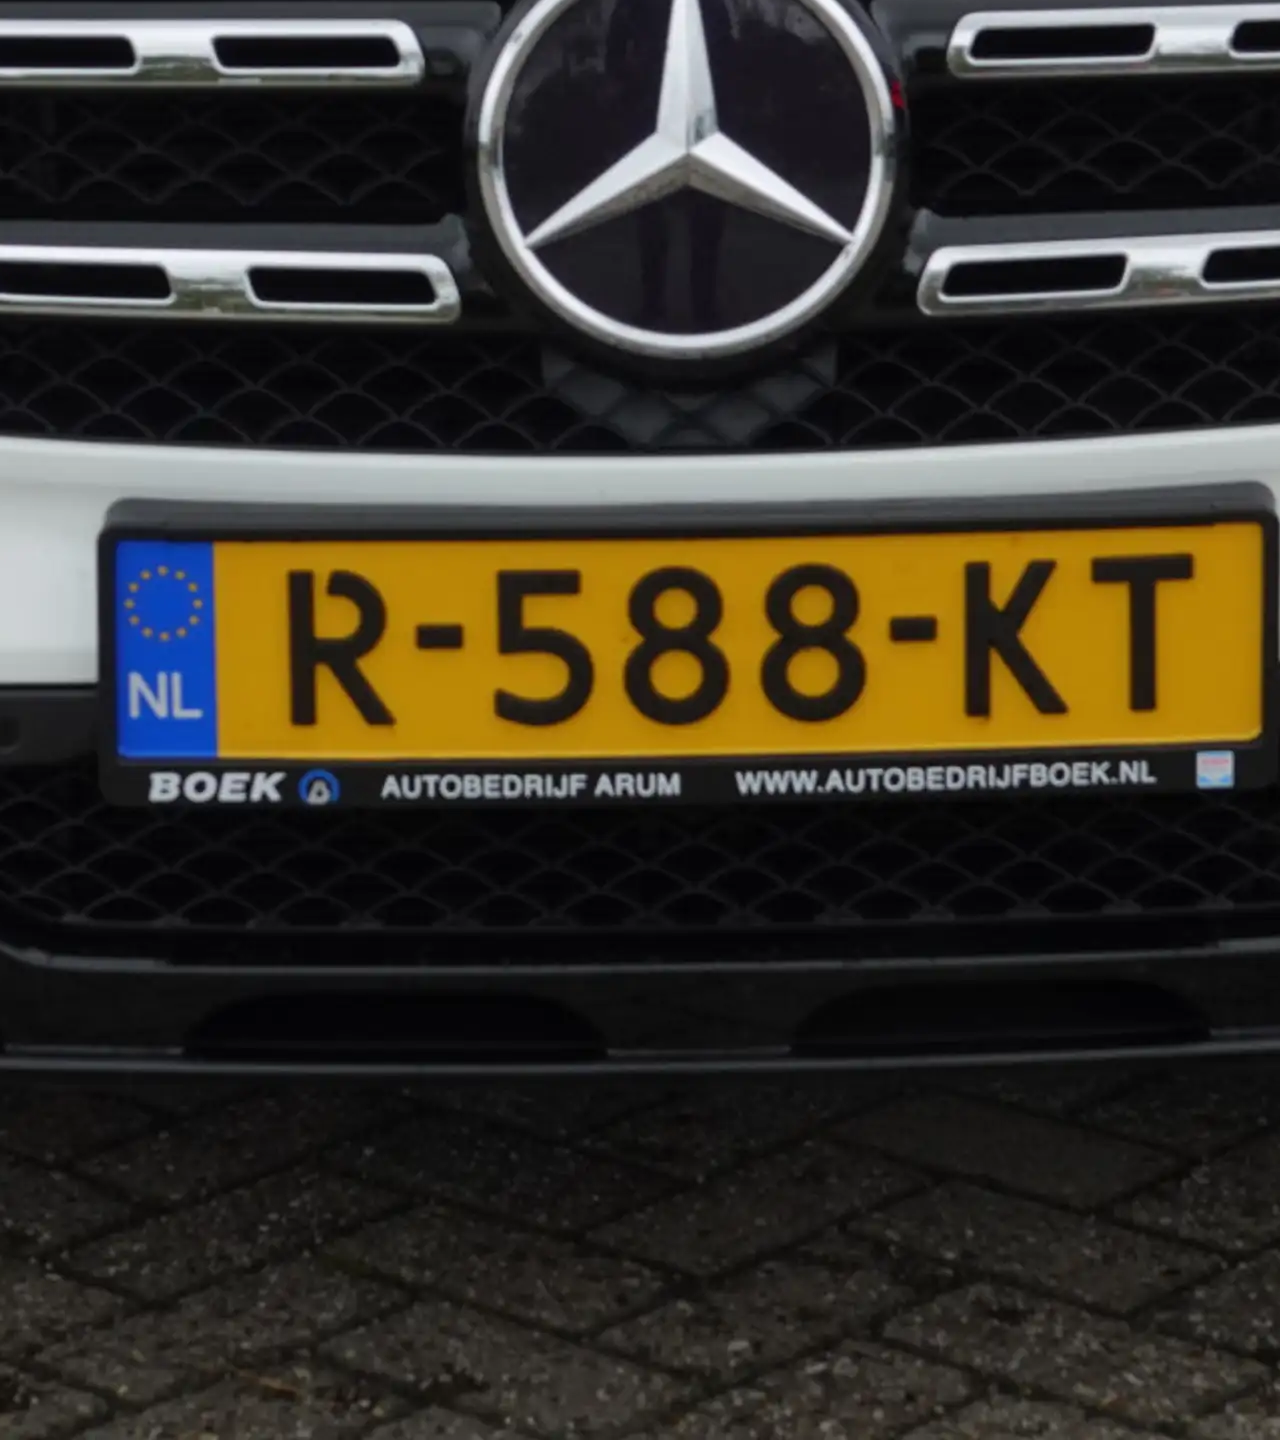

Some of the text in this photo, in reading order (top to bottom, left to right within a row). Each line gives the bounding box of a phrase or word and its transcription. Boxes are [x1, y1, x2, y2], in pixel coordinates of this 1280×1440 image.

[287, 553, 1194, 727] R-588-KT
[129, 674, 201, 720] NL
[148, 771, 286, 803] BOEK
[381, 772, 681, 799] AUTOBEDRIJF ARUM
[735, 760, 1156, 795] WWW.AUTOBEDRIJFBOEK.NL
